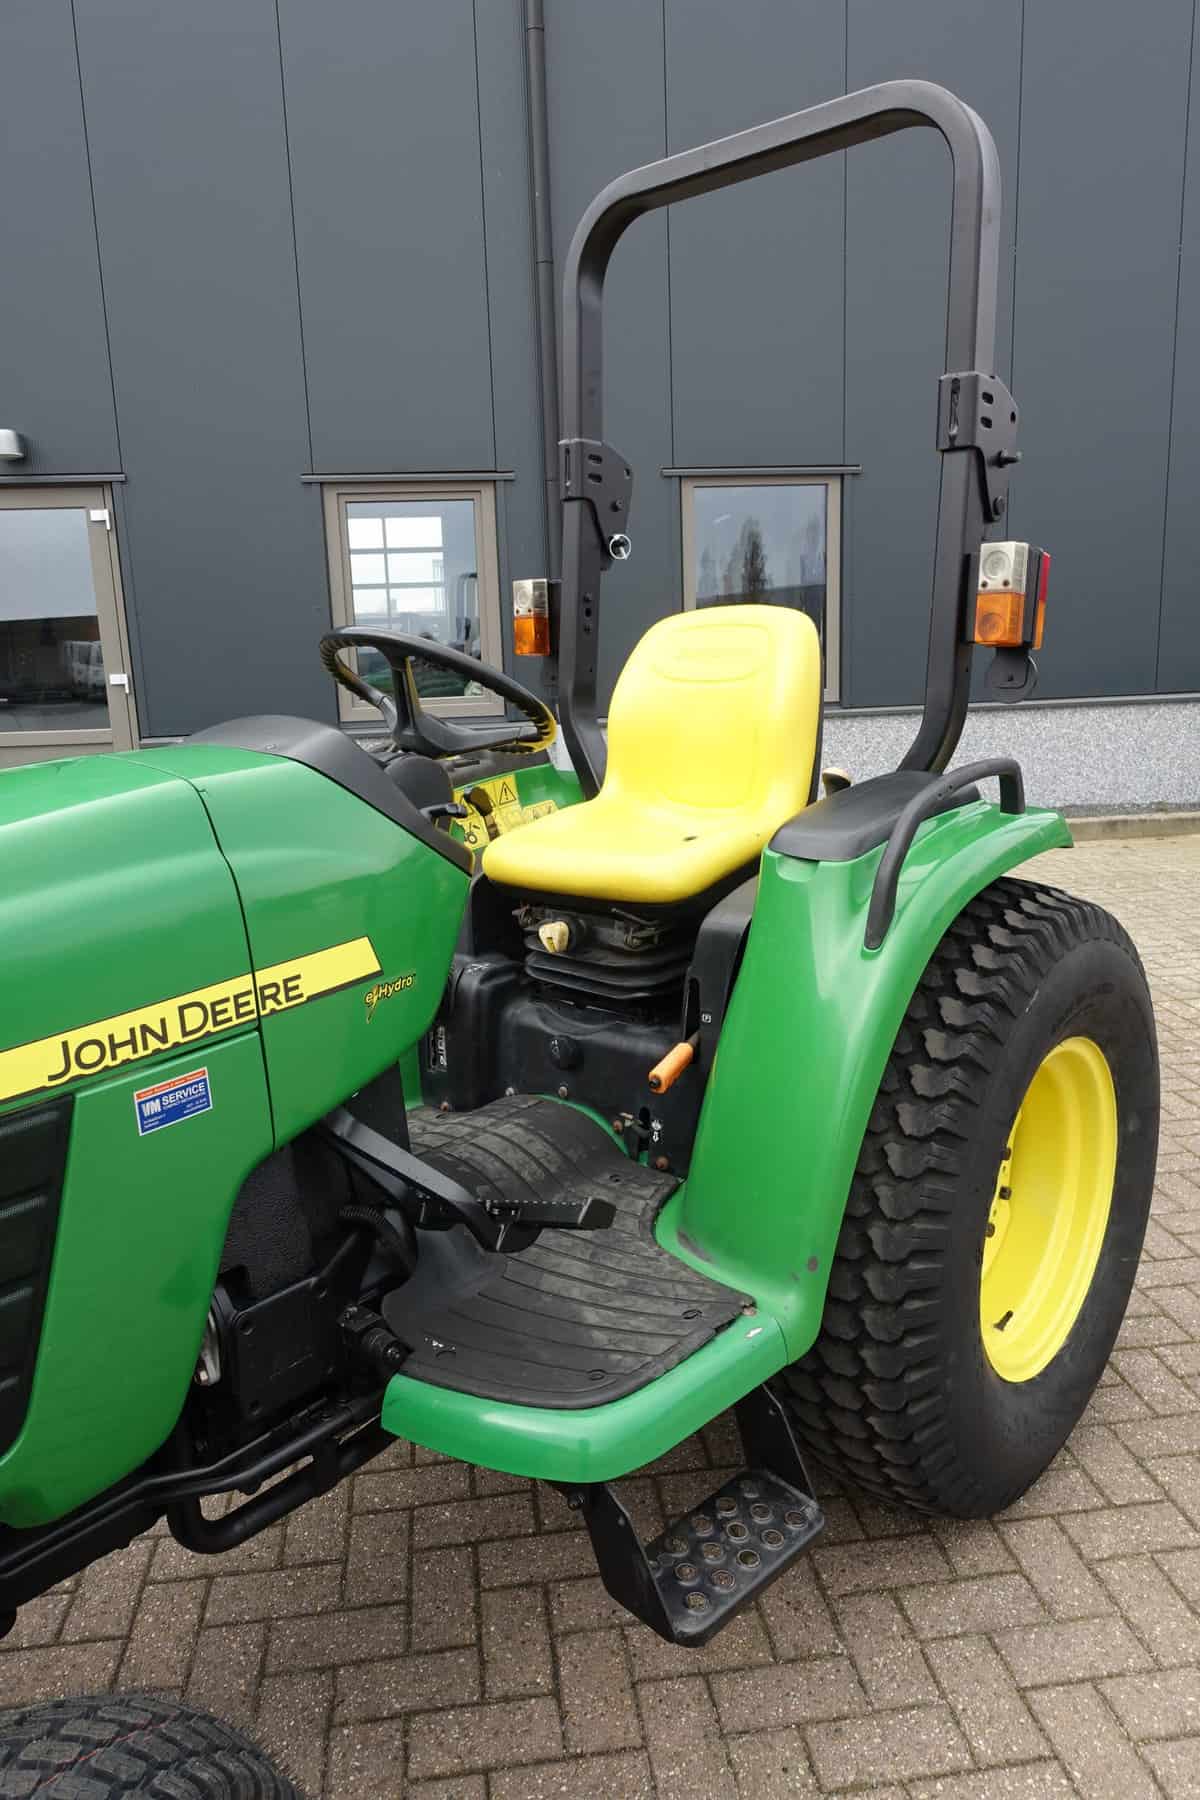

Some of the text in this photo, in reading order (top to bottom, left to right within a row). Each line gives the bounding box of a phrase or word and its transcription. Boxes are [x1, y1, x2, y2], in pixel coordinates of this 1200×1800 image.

[48, 974, 304, 1081] JOHN DEERE
[161, 1082, 205, 1105] SERVICE
